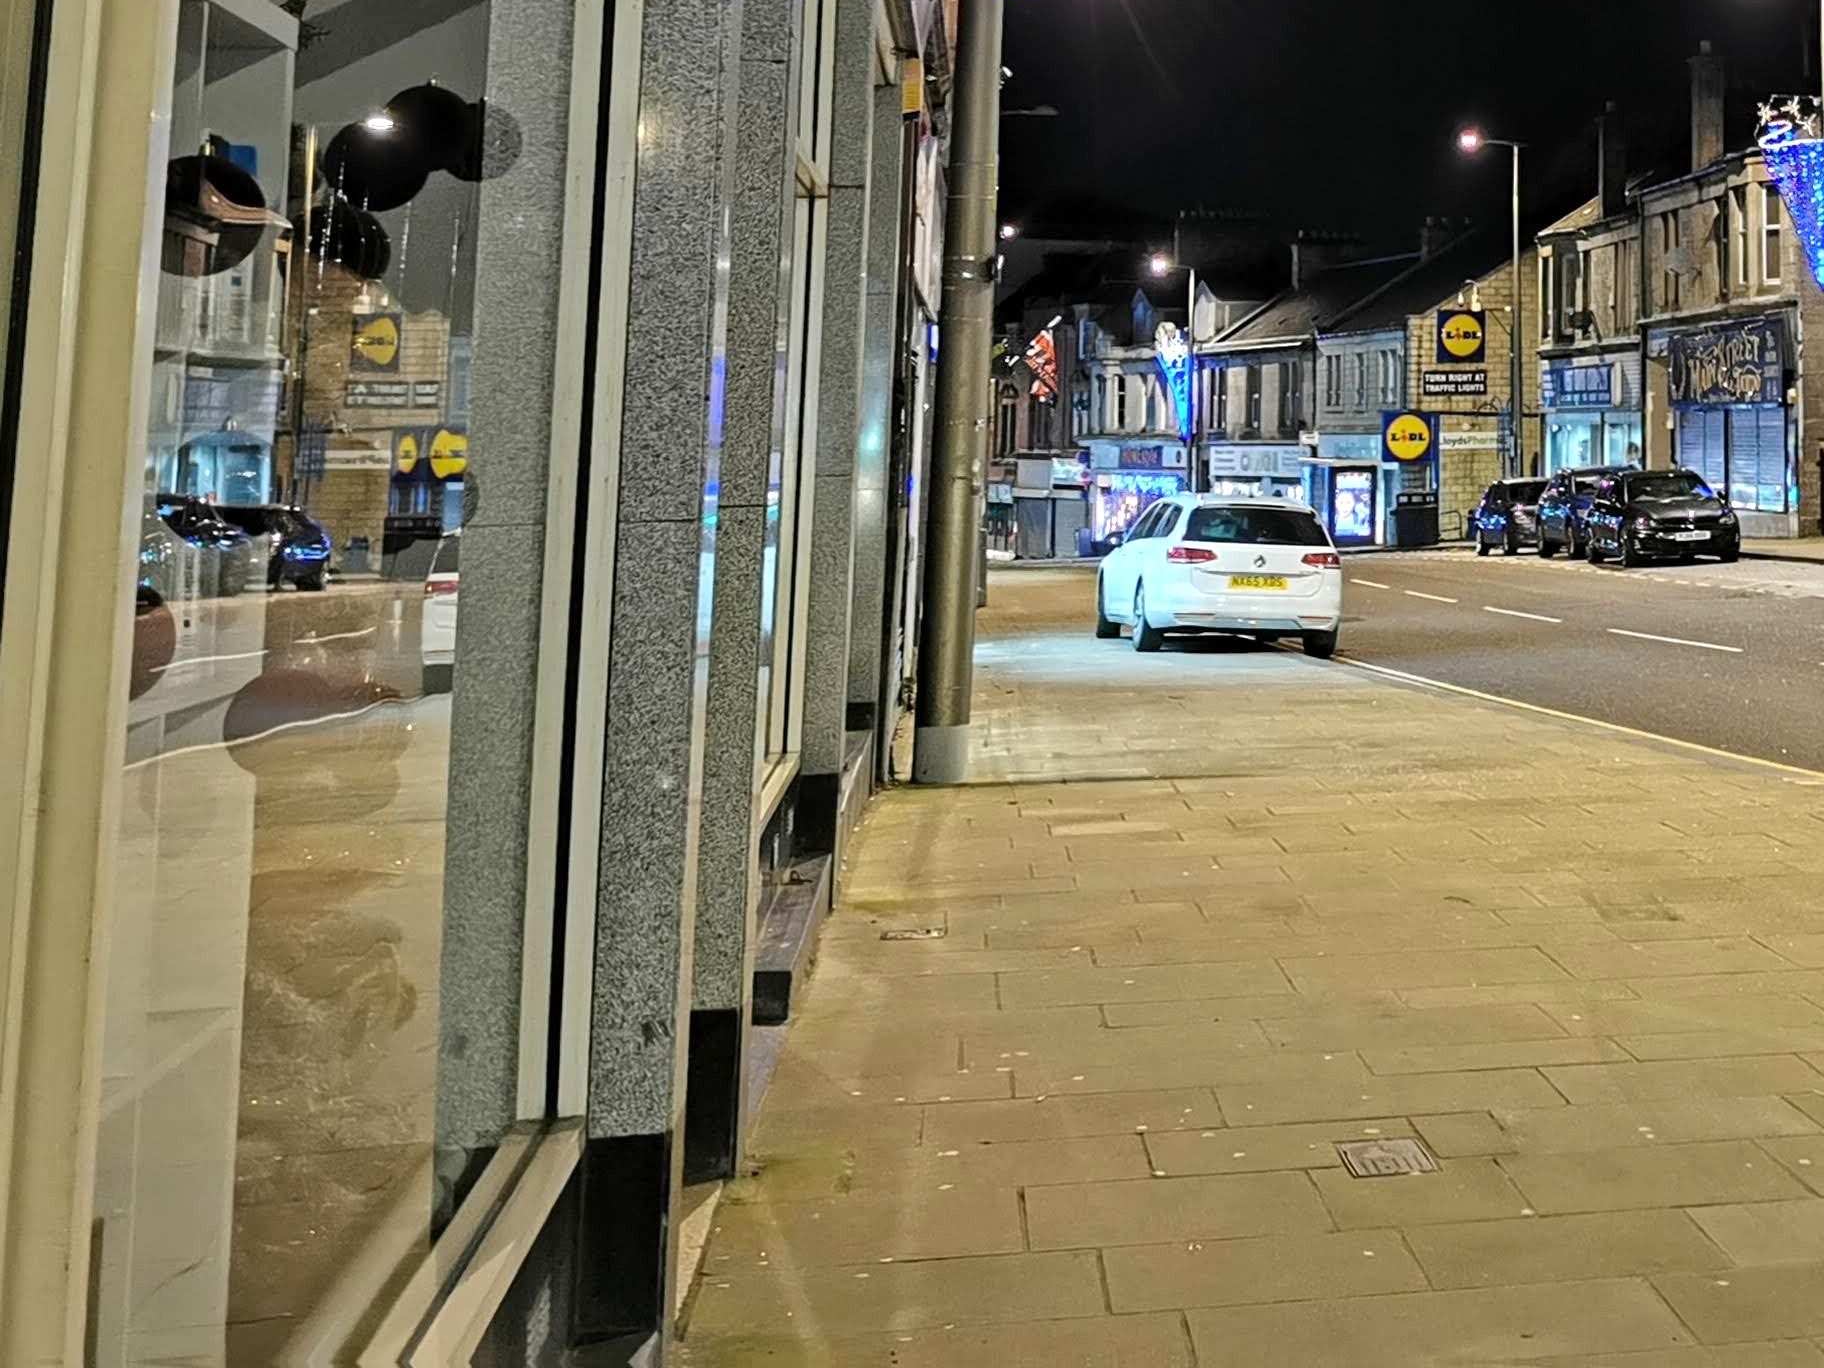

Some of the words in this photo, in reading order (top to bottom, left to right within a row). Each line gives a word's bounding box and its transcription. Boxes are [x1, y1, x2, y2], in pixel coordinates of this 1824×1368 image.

[1424, 373, 1447, 383] TURN
[1448, 373, 1473, 382] RIGHT
[1474, 373, 1485, 382] AT
[1425, 383, 1456, 393] TRAFFIC
[1457, 383, 1485, 392] LIGHTS
